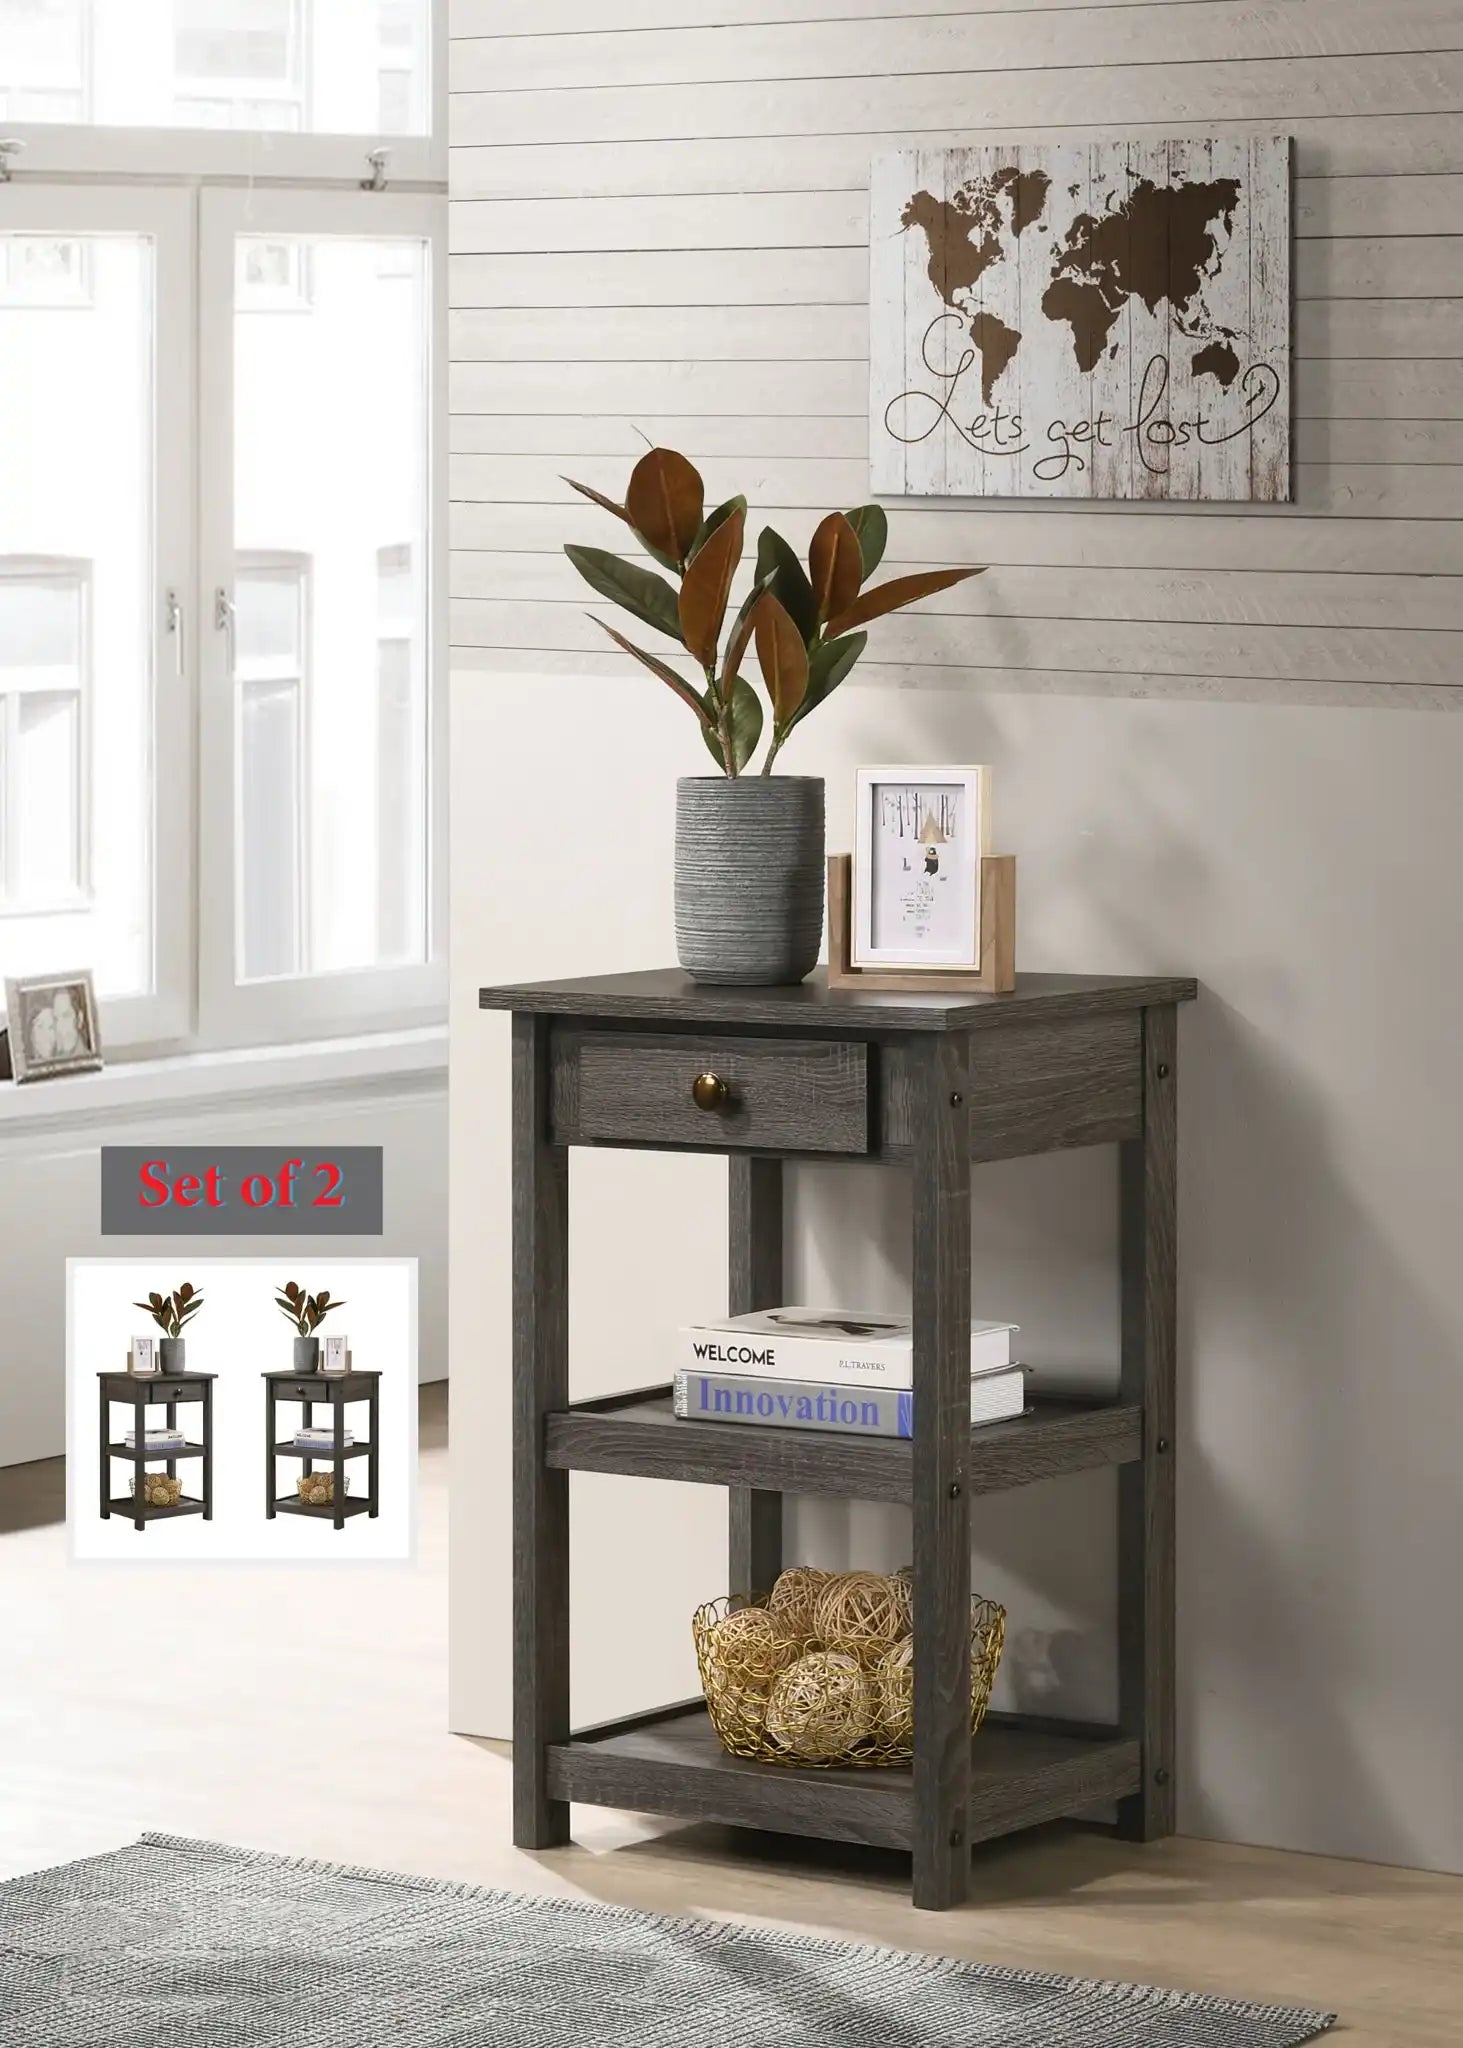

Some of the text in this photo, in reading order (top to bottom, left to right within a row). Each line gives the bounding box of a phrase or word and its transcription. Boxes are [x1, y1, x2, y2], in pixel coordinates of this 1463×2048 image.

[885, 313, 1280, 480] Lets get lost
[693, 1343, 776, 1366] WELCOME
[699, 1378, 880, 1428] Innovation
